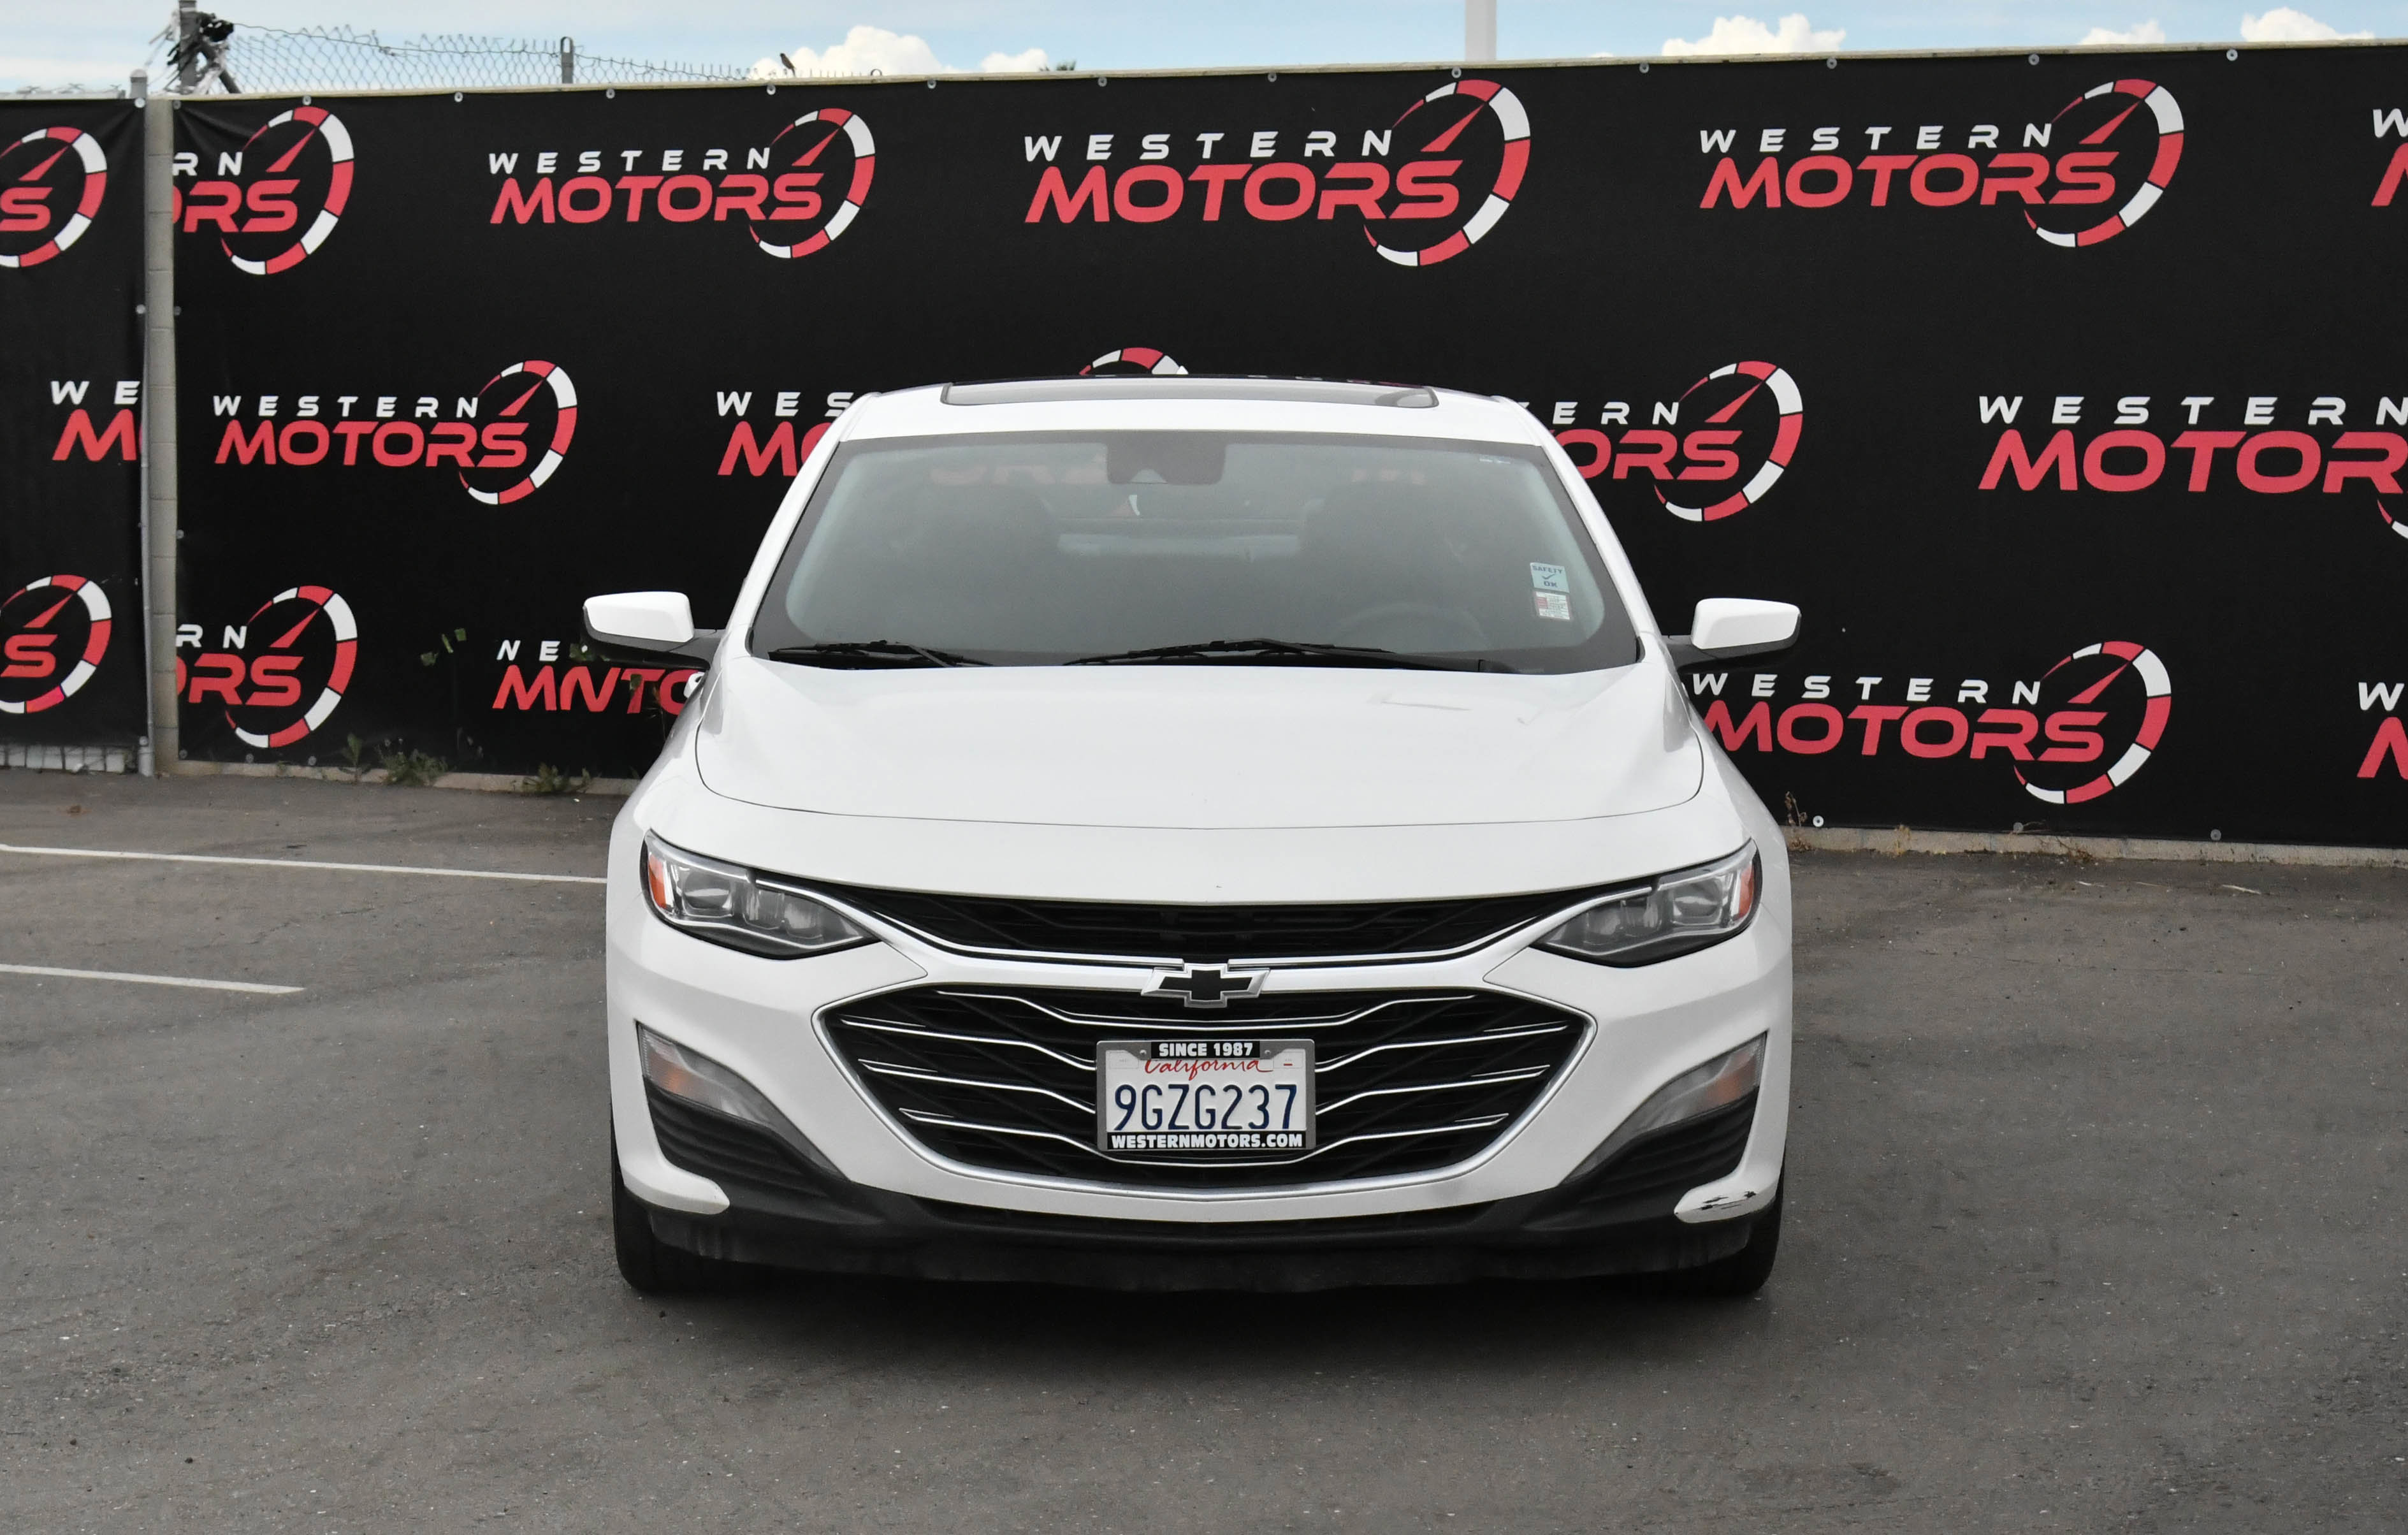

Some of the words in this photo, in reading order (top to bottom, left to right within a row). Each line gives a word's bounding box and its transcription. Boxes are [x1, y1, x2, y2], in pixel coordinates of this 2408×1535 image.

[1024, 129, 1392, 162] WESTERN
[1700, 123, 2052, 154] WESTERN
[489, 147, 771, 175] WESTERN
[1024, 159, 1463, 224] MOTORS
[1700, 151, 2119, 208] MOTORS
[490, 172, 823, 224] MOTORS
[50, 381, 140, 405] WE
[213, 395, 479, 418] WESTERN
[1979, 396, 2408, 426] WESTERN
[215, 419, 529, 469] MOTORS
[1532, 565, 1562, 574] SAFETY
[1692, 673, 2041, 706] WESTERN
[1702, 700, 2108, 763] MOTORS
[1159, 1043, 1207, 1057] SINCE
[1214, 1042, 1254, 1056] 1987
[1145, 1059, 1273, 1081] California
[1114, 1084, 1297, 1130] 9GZG237
[1112, 1133, 1302, 1148] WESTERNMOTORS.COM
